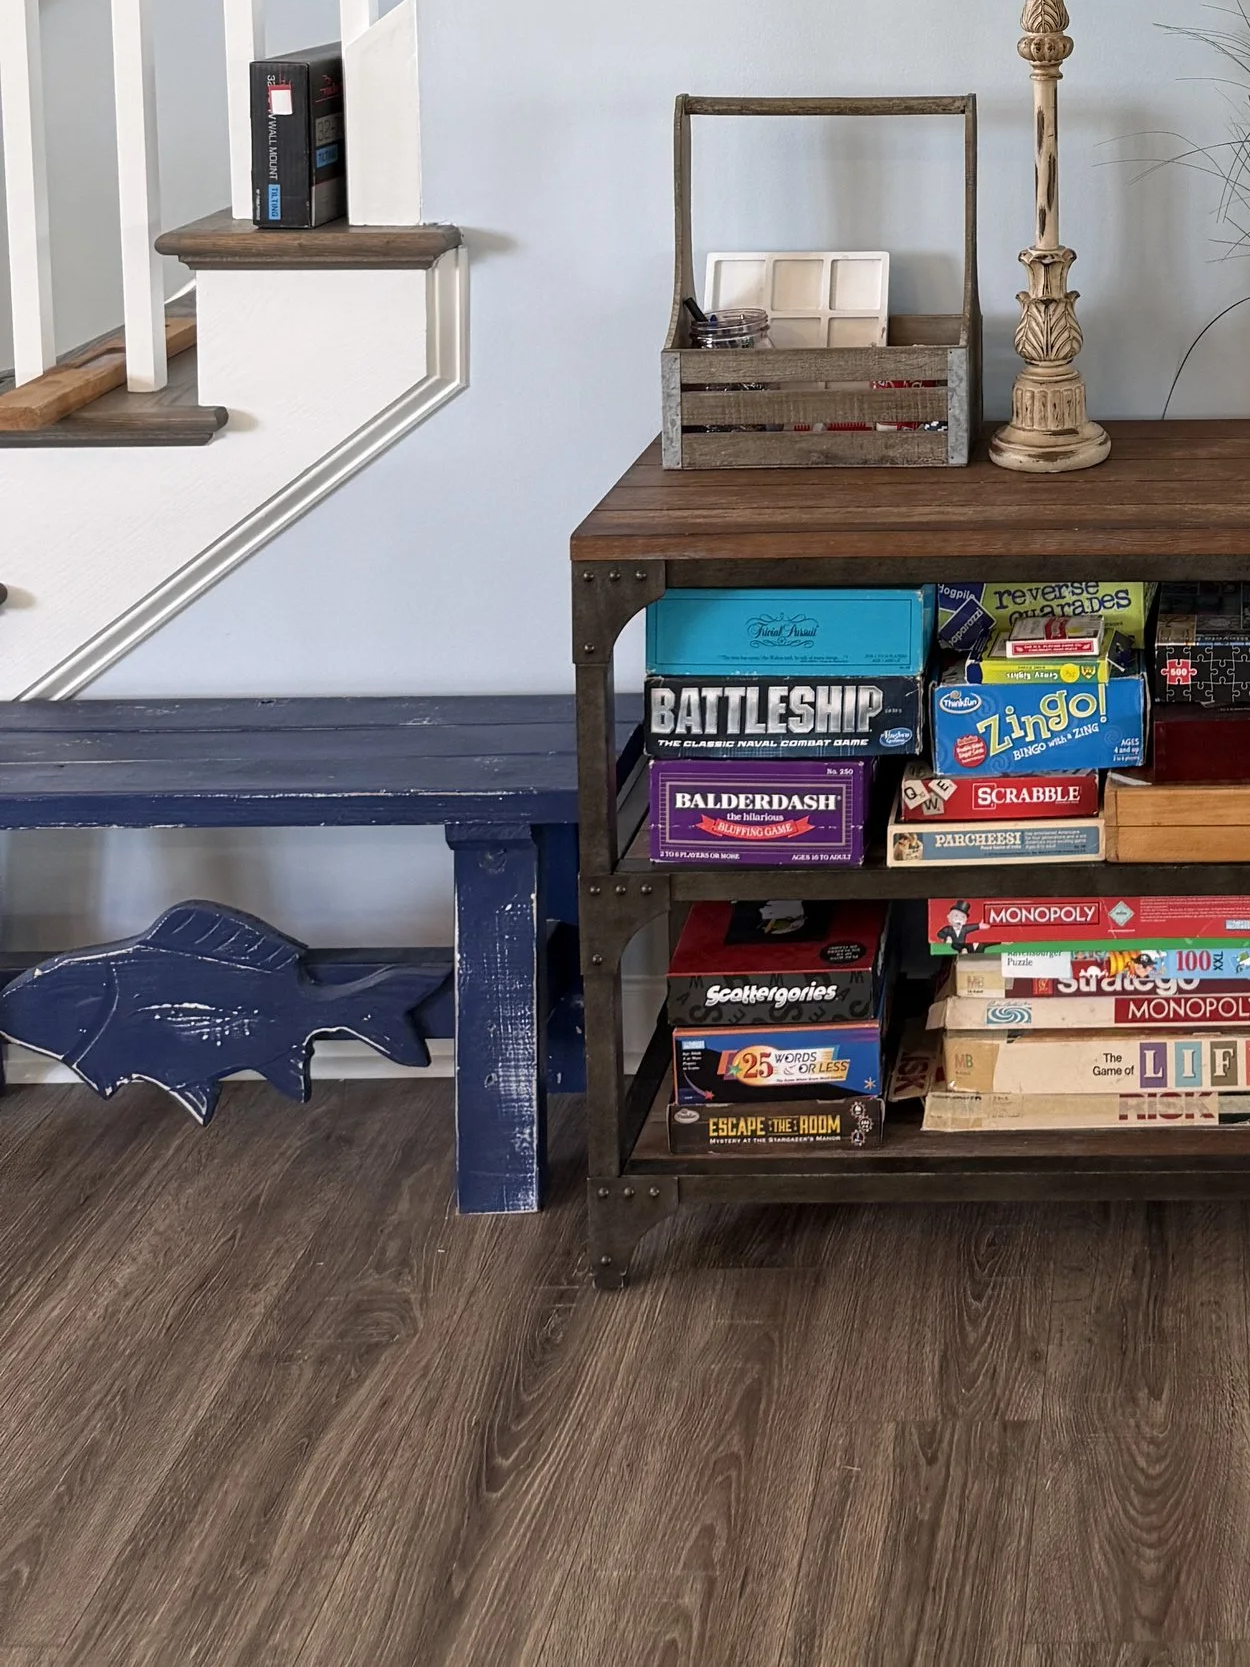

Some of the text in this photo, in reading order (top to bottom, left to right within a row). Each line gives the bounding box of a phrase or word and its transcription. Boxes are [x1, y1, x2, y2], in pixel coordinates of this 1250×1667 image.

[268, 121, 278, 180] WALL MOUNT
[1170, 667, 1188, 677] 500
[651, 685, 884, 734] BATTLESHIP
[976, 683, 1108, 757] Zingo!
[658, 739, 681, 747] THE
[780, 739, 829, 747] COMBAT
[834, 738, 869, 746] GAME
[1013, 723, 1100, 761] BINGO with ZING
[1121, 738, 1139, 746] AGES
[1131, 747, 1139, 756] up
[904, 786, 918, 800] Q
[937, 780, 949, 792] E
[675, 792, 837, 810] BALDERDASH
[977, 785, 1080, 806] SCRABBLE
[924, 798, 938, 810] W
[727, 811, 784, 822] the hilarious
[716, 820, 794, 837] BLUFFING GAME
[935, 831, 1022, 848] PARCHEESI
[989, 905, 1096, 925] MONOPOLY
[1007, 957, 1033, 968] Puzzle
[1177, 951, 1211, 971] 100
[1213, 951, 1224, 971] XXL
[705, 982, 838, 1009] Scattergories
[743, 1052, 774, 1079] 25
[775, 1052, 817, 1063] WORDS
[954, 1054, 974, 1069] MB
[1103, 1053, 1122, 1063] The
[799, 1061, 849, 1074] OR LESS
[1092, 1065, 1135, 1076] Game of
[709, 1115, 841, 1136] ESCAPE THE ROOM
